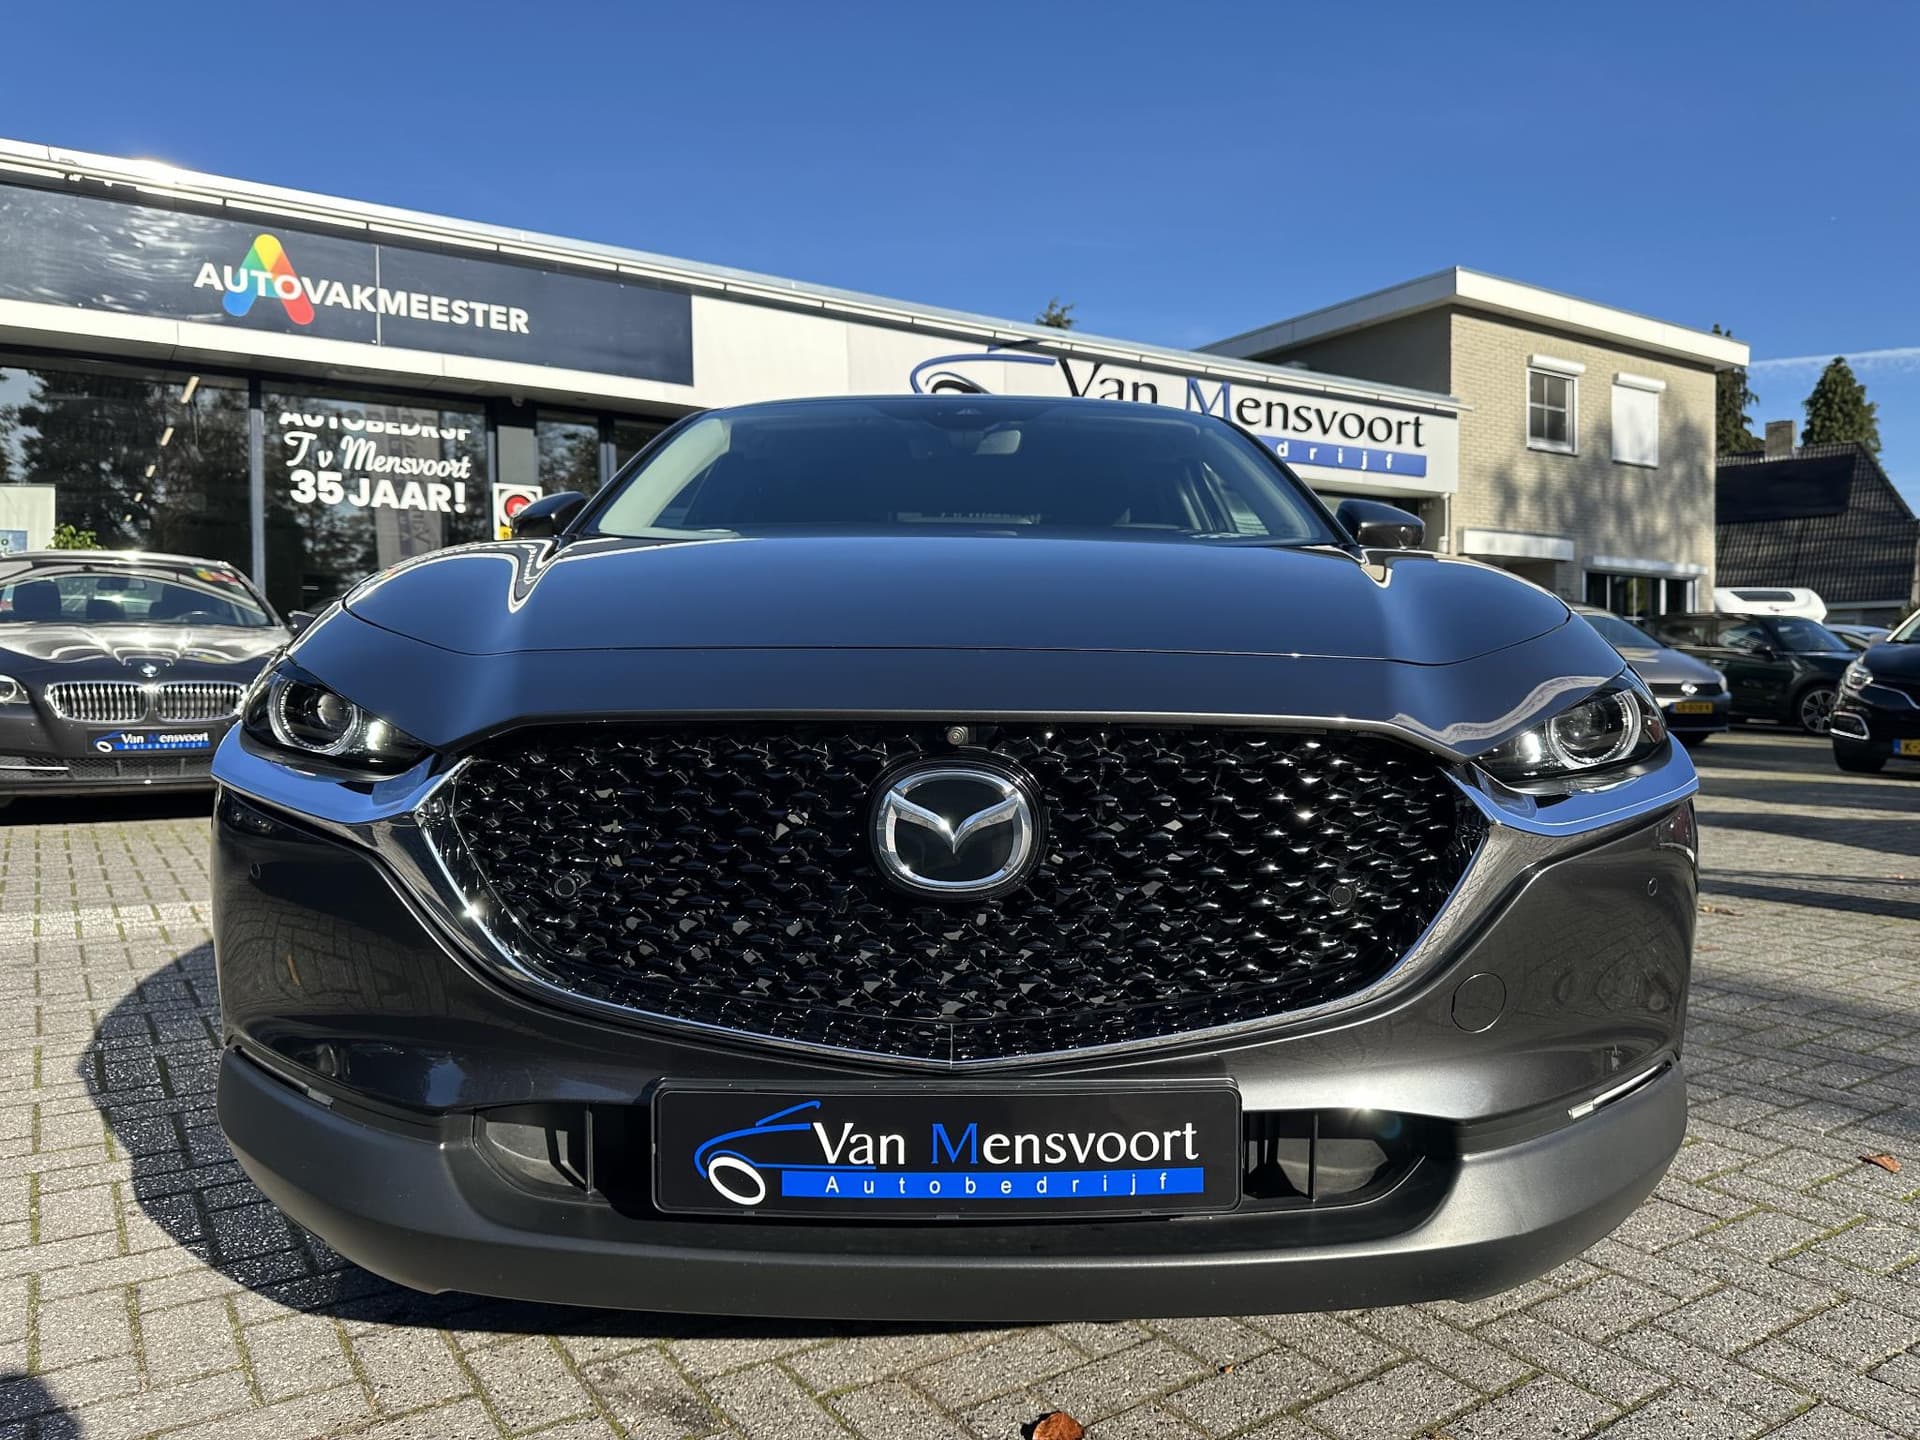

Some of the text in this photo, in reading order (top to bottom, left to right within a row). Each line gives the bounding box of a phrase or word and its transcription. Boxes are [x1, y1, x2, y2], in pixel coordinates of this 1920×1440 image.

[194, 262, 529, 334] AUTOVAKMEESTER
[1057, 356, 1425, 448] Van Mensvoort
[340, 435, 472, 480] Mensvoort
[290, 469, 467, 514] 35 JAAR!
[121, 733, 144, 743] Van
[811, 1122, 1200, 1166] Van Mensvoort
[825, 1172, 1168, 1197] Autobedrijf
